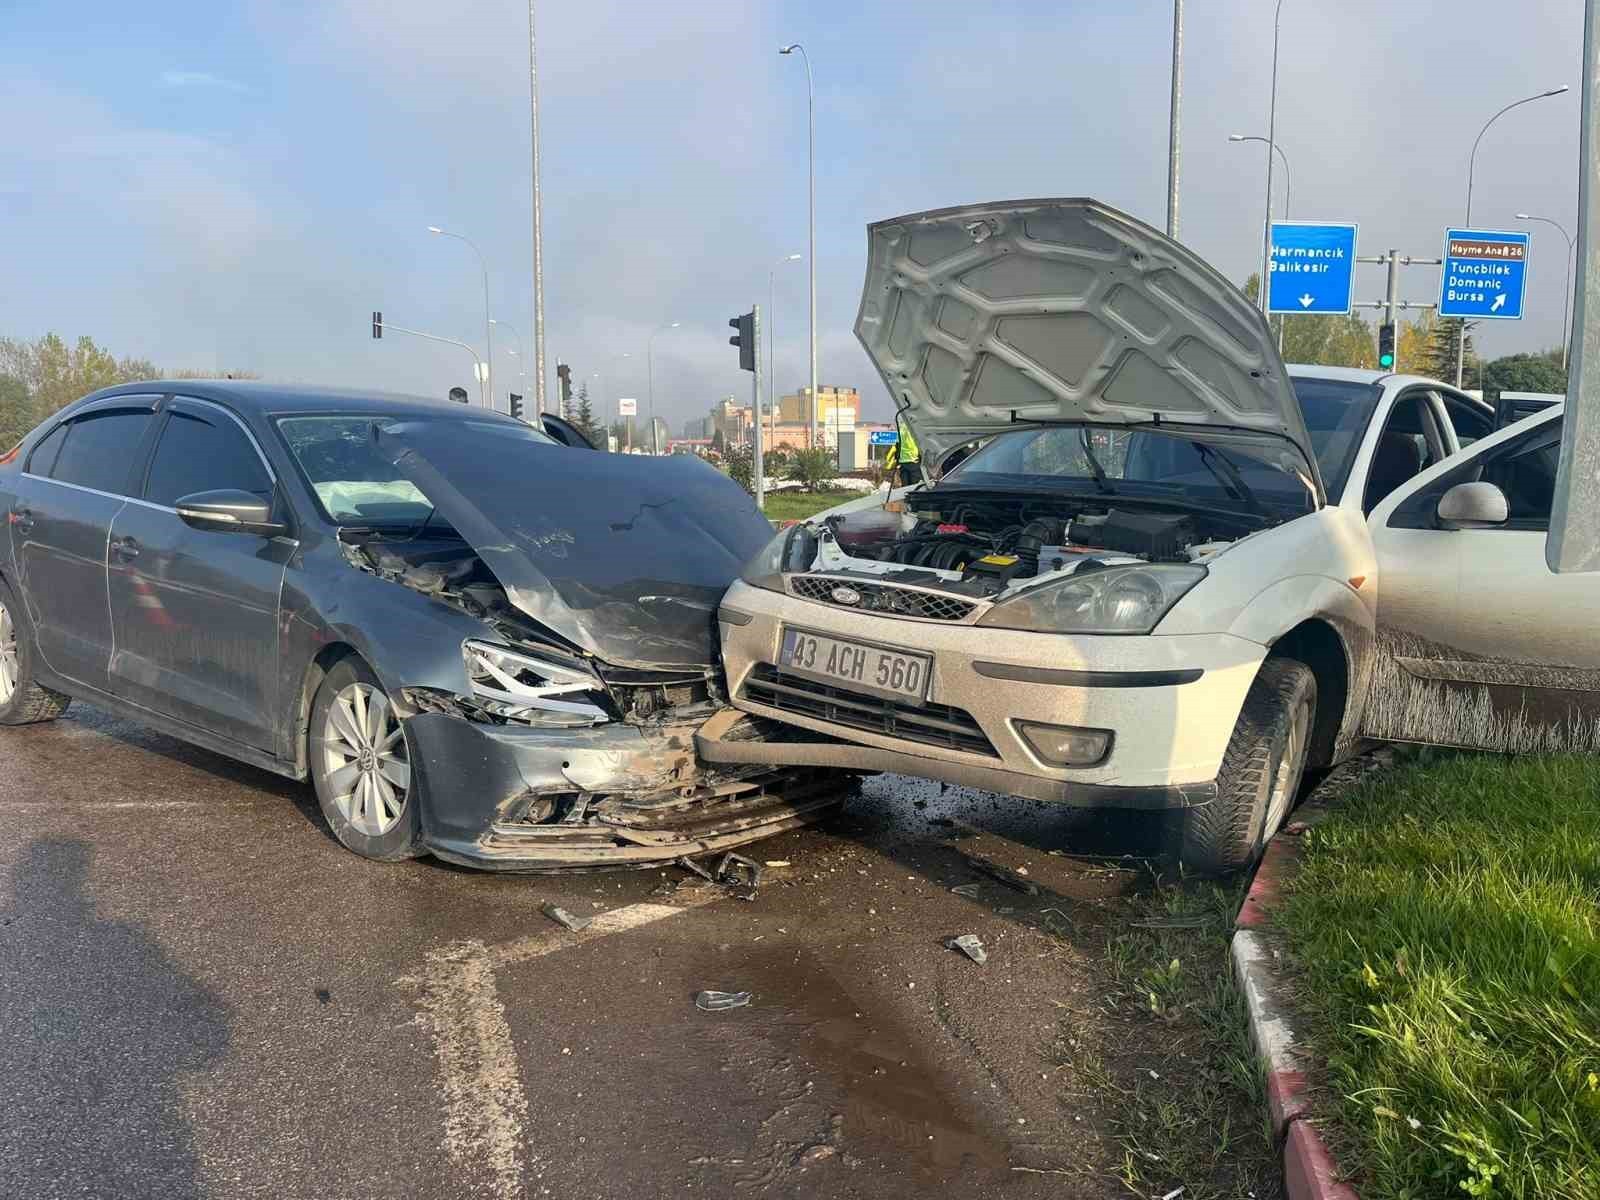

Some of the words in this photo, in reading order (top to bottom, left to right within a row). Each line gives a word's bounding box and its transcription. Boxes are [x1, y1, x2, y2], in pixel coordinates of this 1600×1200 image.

[1271, 245, 1344, 258] Harmancık
[1451, 243, 1482, 255] Hayme
[1451, 262, 1510, 275] Tunçbilek
[1449, 276, 1502, 290] Domaniç
[1447, 290, 1484, 302] Bursa
[793, 636, 817, 668] 43
[826, 643, 866, 681] ACH
[876, 654, 921, 693] 560
